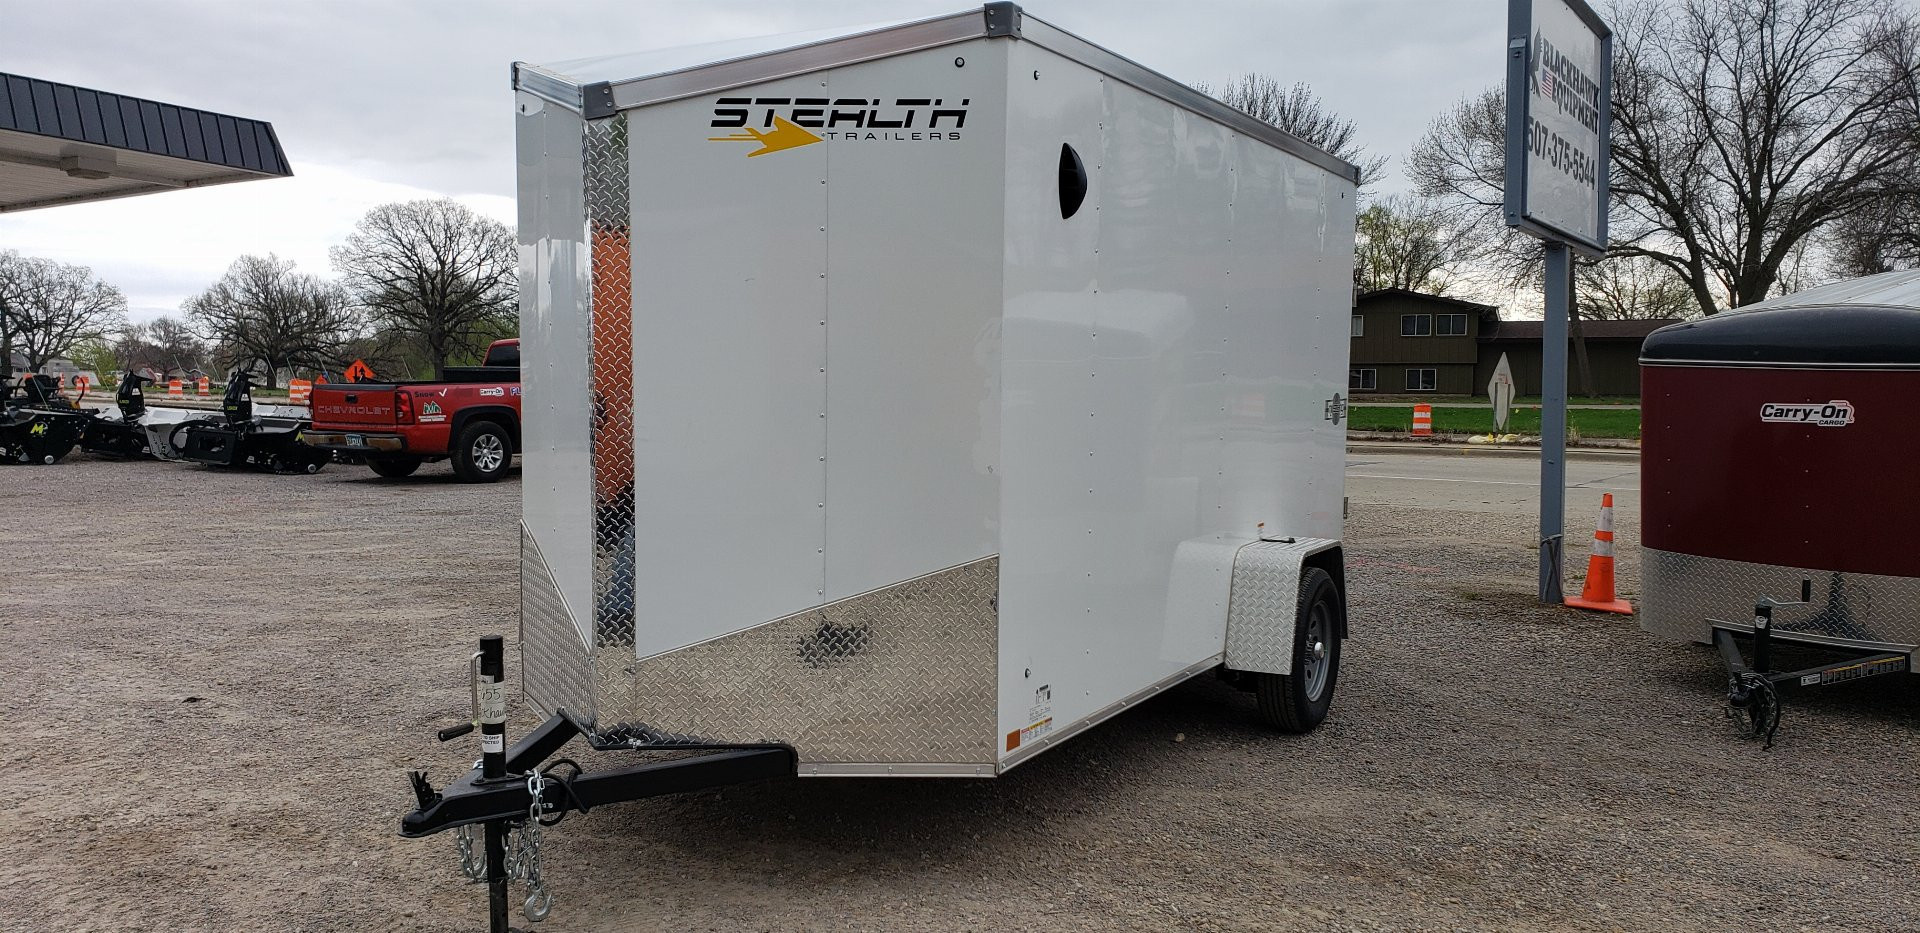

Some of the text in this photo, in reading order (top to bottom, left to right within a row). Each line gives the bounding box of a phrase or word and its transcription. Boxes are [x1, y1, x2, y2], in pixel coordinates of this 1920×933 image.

[1542, 37, 1600, 112] BLACKHAWK
[711, 97, 970, 128] STEALTH
[1552, 75, 1599, 136] EQUIPMENT
[827, 132, 961, 141] TRAILERS
[1528, 115, 1595, 191] 507-375-5544
[480, 388, 503, 396] Carry-On
[510, 386, 521, 396] FL
[317, 405, 391, 415] CHEVROLET
[1761, 404, 1847, 421] Carry-On
